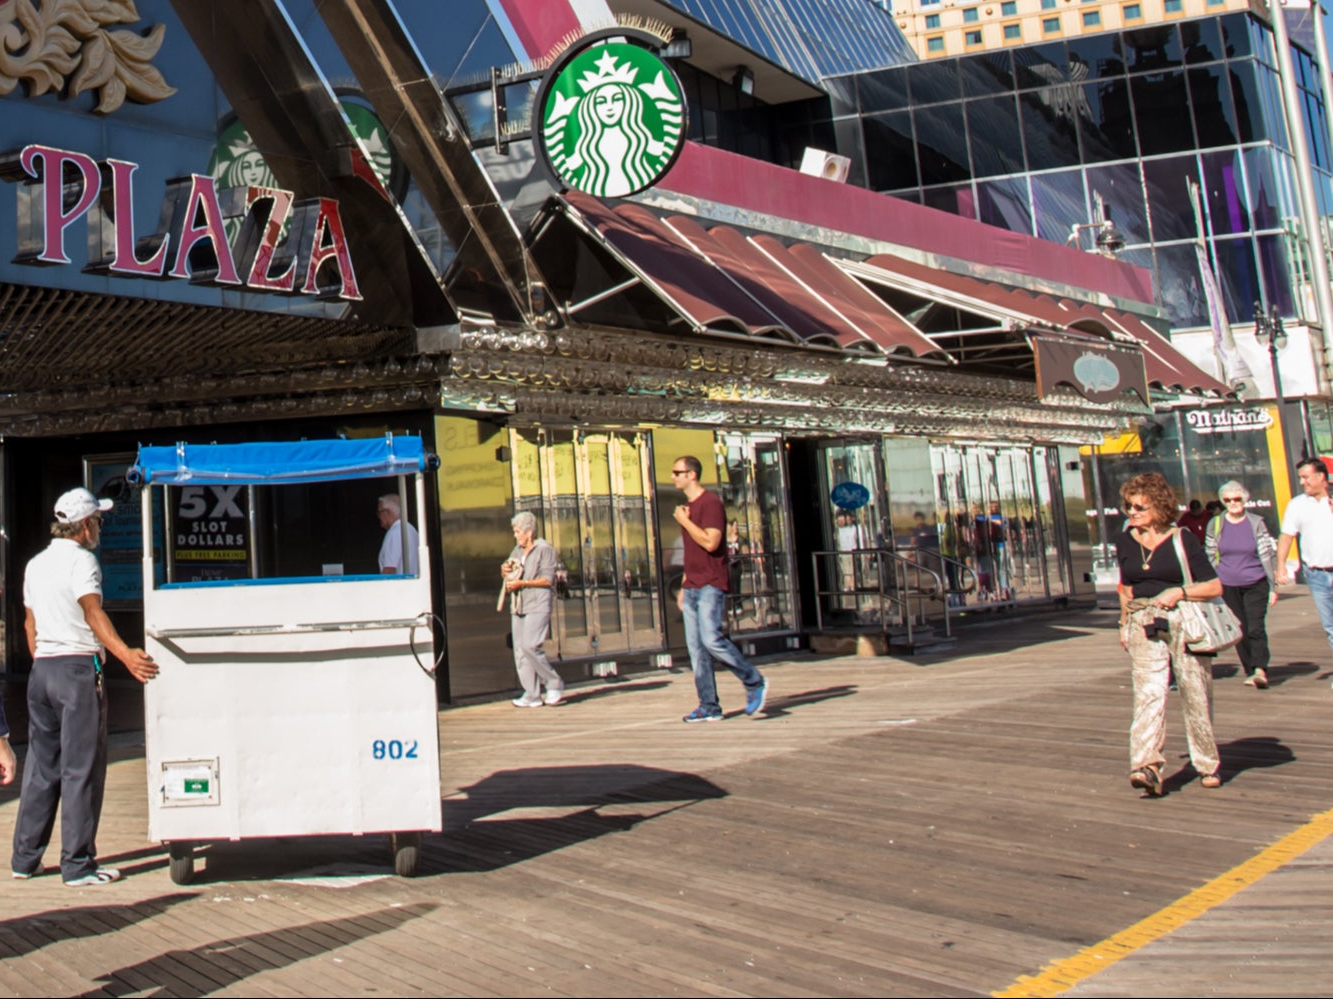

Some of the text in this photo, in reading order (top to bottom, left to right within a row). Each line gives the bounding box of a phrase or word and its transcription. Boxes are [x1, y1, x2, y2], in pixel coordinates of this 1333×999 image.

[18, 144, 364, 301] PLAZA
[178, 485, 244, 518] 5X
[191, 521, 227, 533] SLOT
[177, 534, 244, 546] DOLLARS
[372, 739, 418, 760] 802
